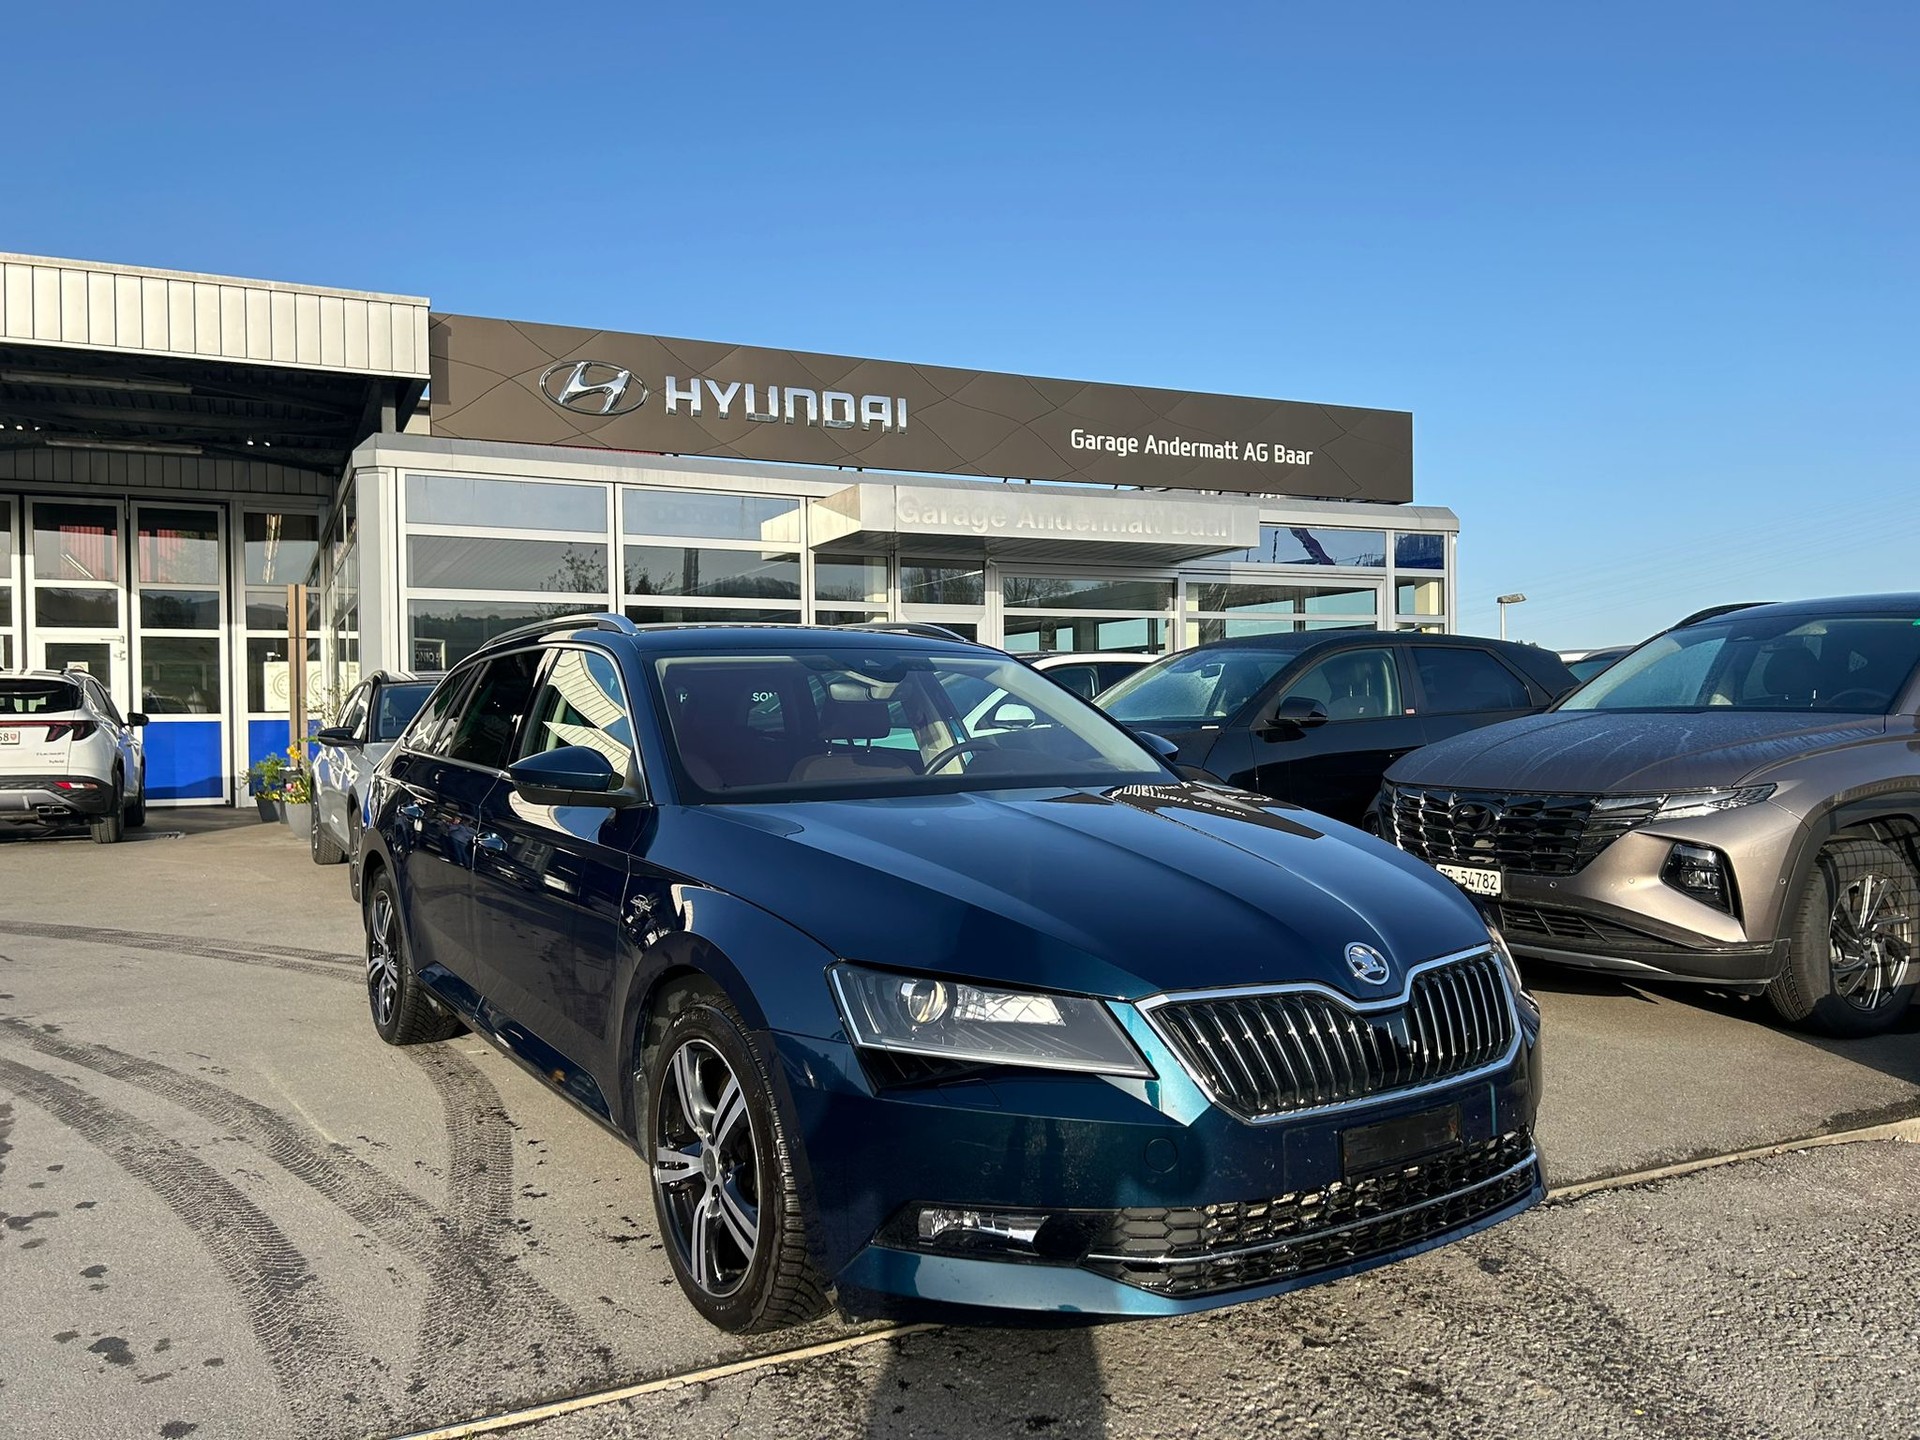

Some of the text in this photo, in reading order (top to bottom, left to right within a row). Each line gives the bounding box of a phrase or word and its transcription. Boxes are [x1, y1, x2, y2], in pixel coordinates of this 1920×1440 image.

[665, 375, 908, 434] HYUNDAI
[1070, 428, 1314, 466] Garage Andermatt AG Baar
[899, 494, 1007, 533] Garage
